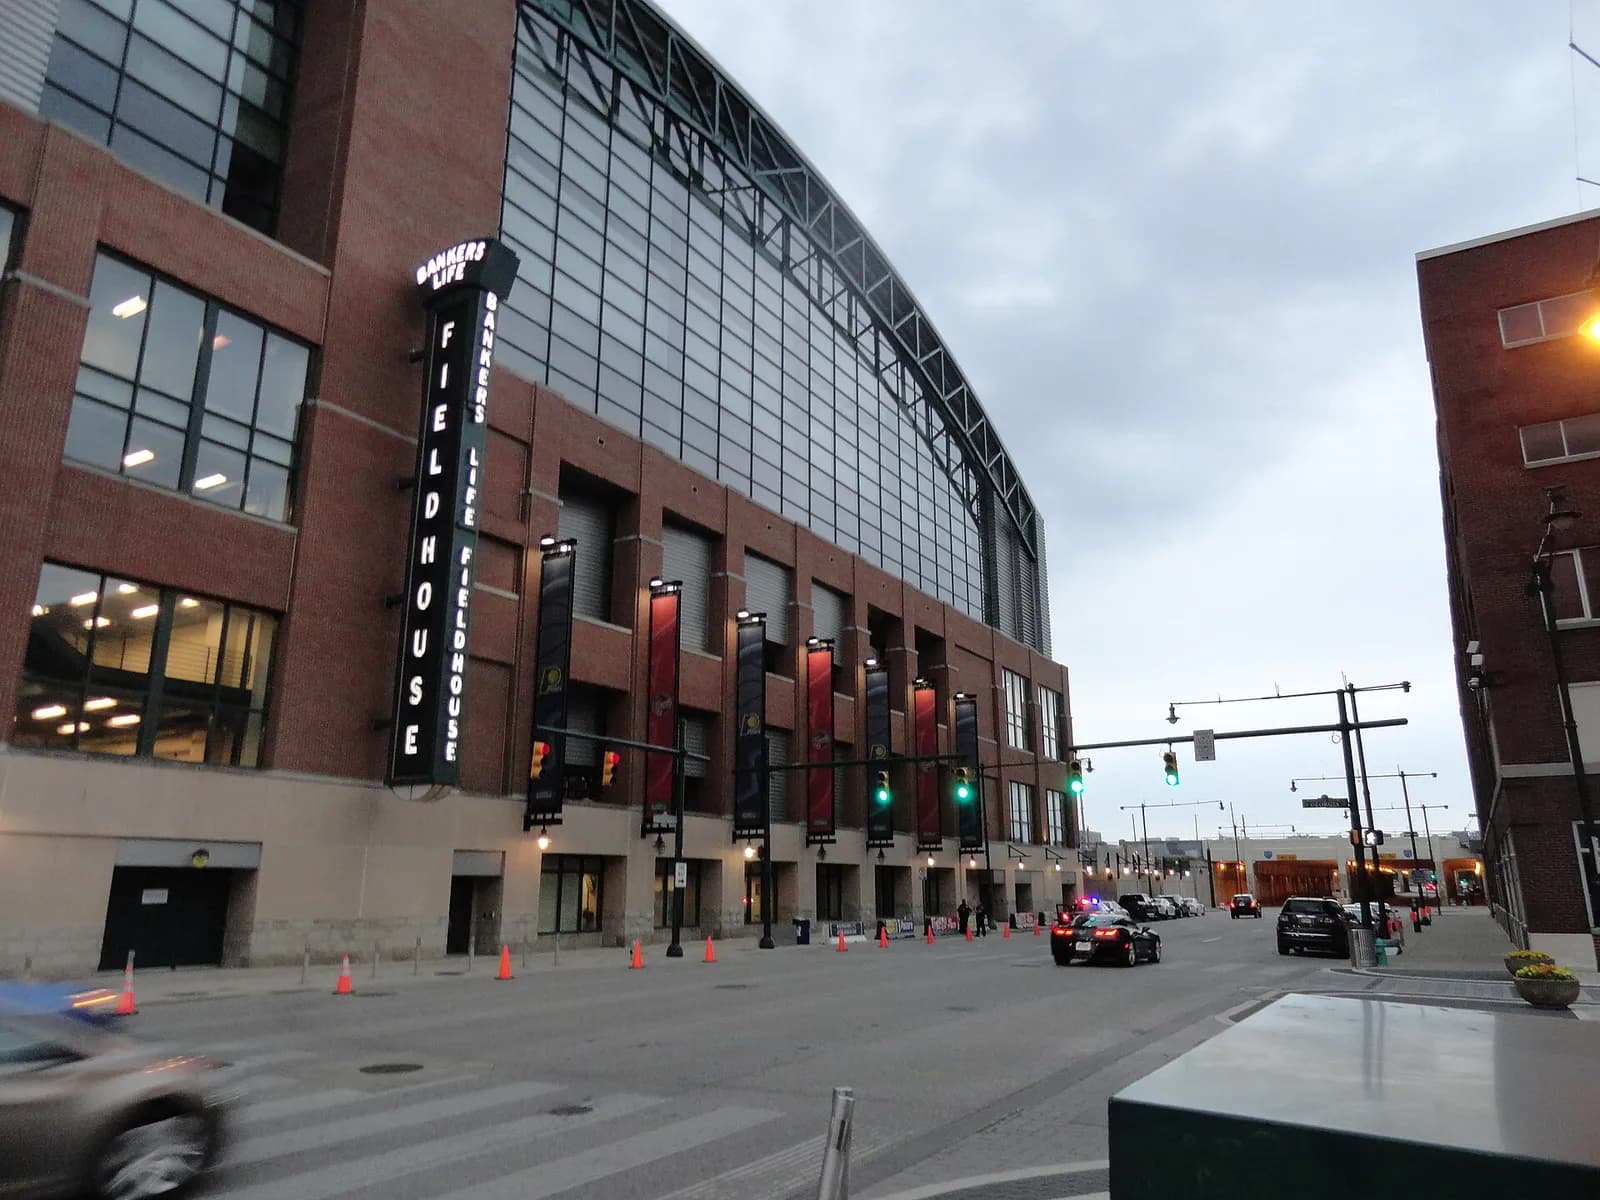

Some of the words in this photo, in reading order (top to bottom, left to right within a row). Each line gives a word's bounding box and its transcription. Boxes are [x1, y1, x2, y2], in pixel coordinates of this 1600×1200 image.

[416, 241, 486, 285] BANKERS
[433, 261, 466, 290] LIFE
[474, 291, 498, 424] BANKERS
[404, 321, 455, 755] FIELDHOUSE
[463, 447, 479, 526] LIFE
[446, 546, 472, 762] FIELDHOUSE
